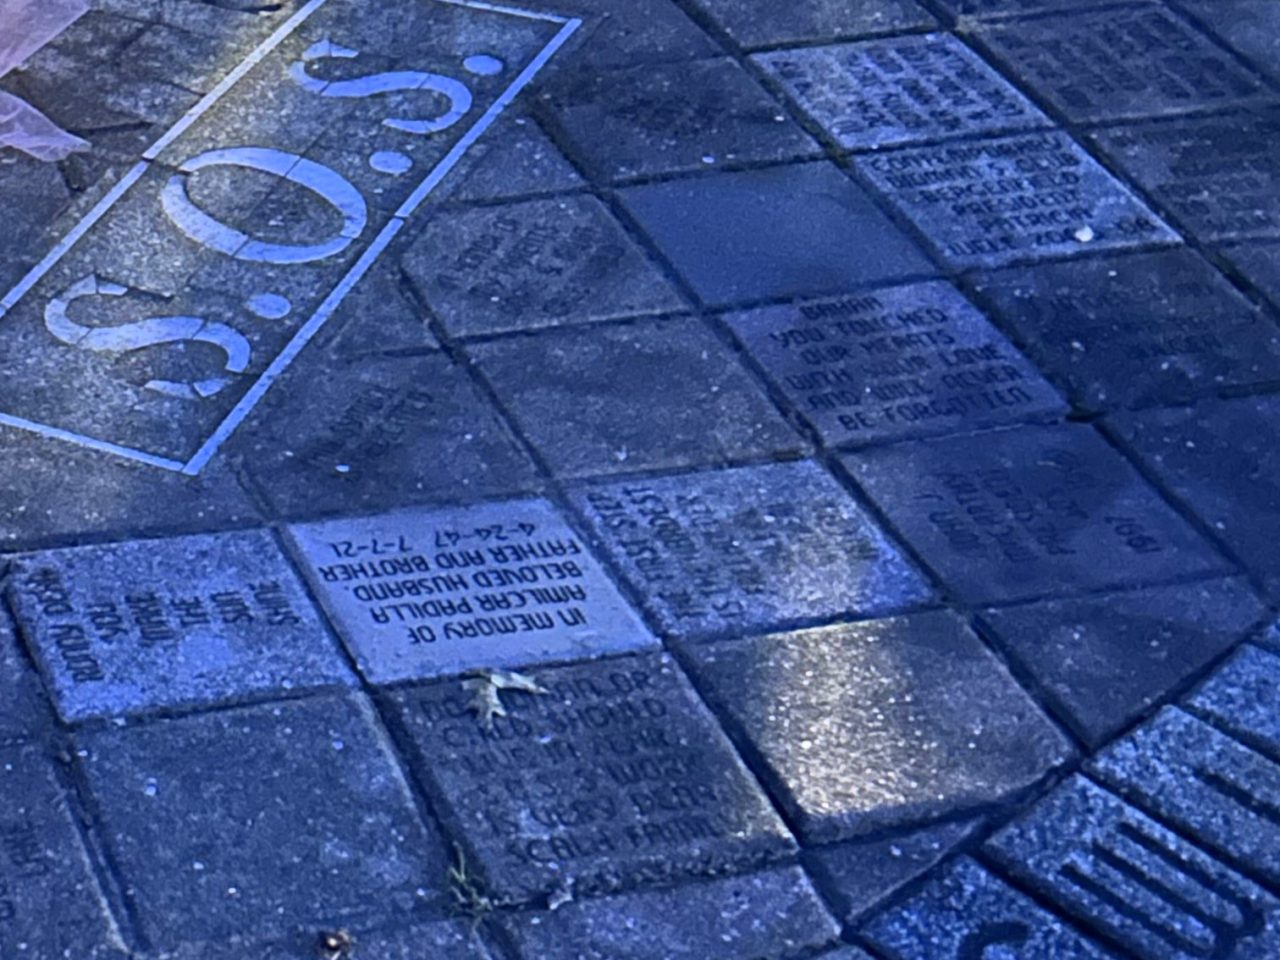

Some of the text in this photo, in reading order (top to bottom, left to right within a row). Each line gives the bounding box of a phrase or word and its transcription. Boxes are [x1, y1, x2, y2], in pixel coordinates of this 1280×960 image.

[43, 39, 503, 398] S.O.S.
[767, 325, 828, 348] YOU
[796, 343, 856, 366] OUR
[783, 367, 855, 391] WITH
[802, 388, 863, 411] AND
[834, 410, 878, 431] BE
[327, 520, 541, 560] 4-24-47 7-7-21
[317, 537, 584, 583] FATHER AND BROTHER
[469, 560, 584, 589] BELOVED
[169, 595, 212, 628] THE
[209, 590, 256, 625] SUN
[367, 582, 590, 626] AMILCAR PADILLA
[401, 607, 590, 645] IN MEMORY OF
[606, 669, 657, 693] OR
